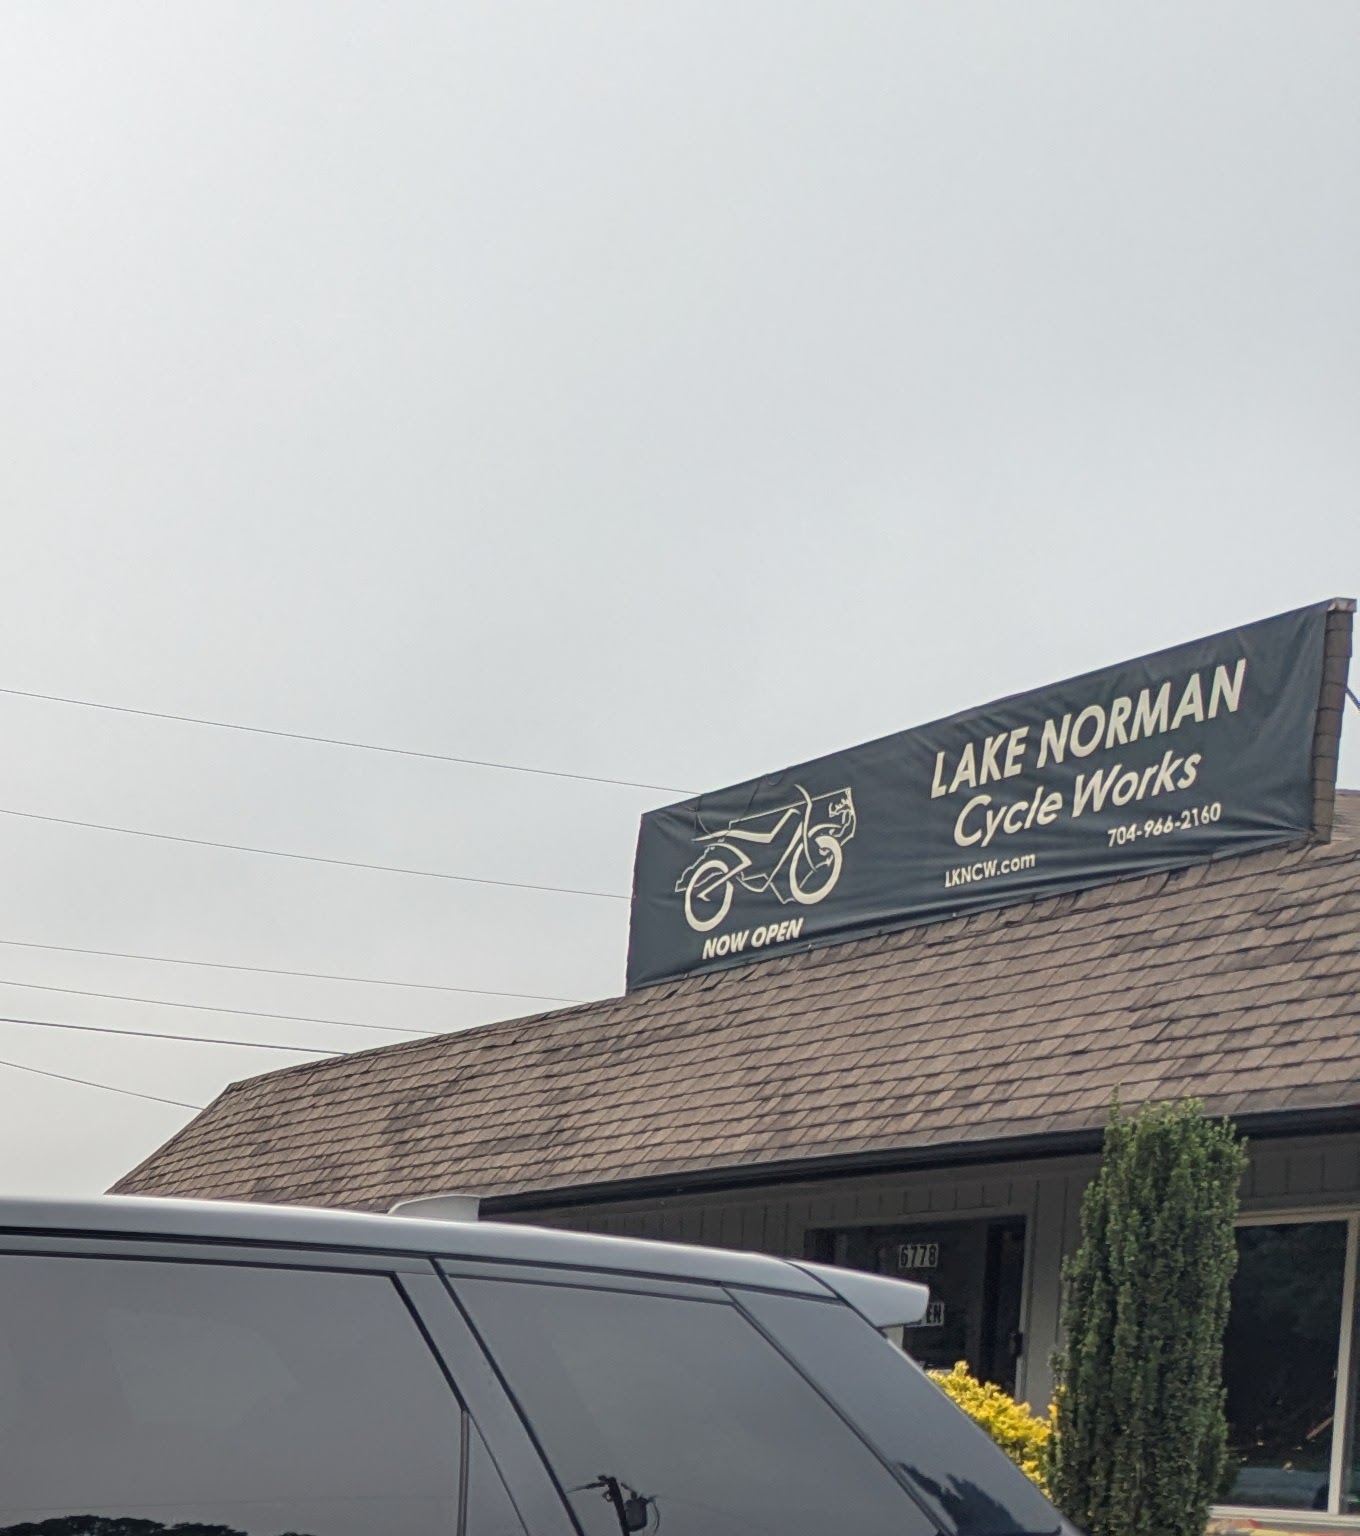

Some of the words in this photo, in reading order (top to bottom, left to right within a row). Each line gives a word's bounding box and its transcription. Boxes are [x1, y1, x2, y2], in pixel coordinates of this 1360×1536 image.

[930, 727, 1027, 799] LAKE
[1037, 659, 1247, 769] NORMAN
[953, 789, 1062, 849] Cycle
[1070, 751, 1201, 819] Works
[1107, 803, 1223, 848] 704-966-2160
[944, 852, 1037, 888] LKNCW.com
[702, 926, 749, 959] NOW
[751, 916, 804, 950] OPEN
[901, 1246, 937, 1267] 6778
